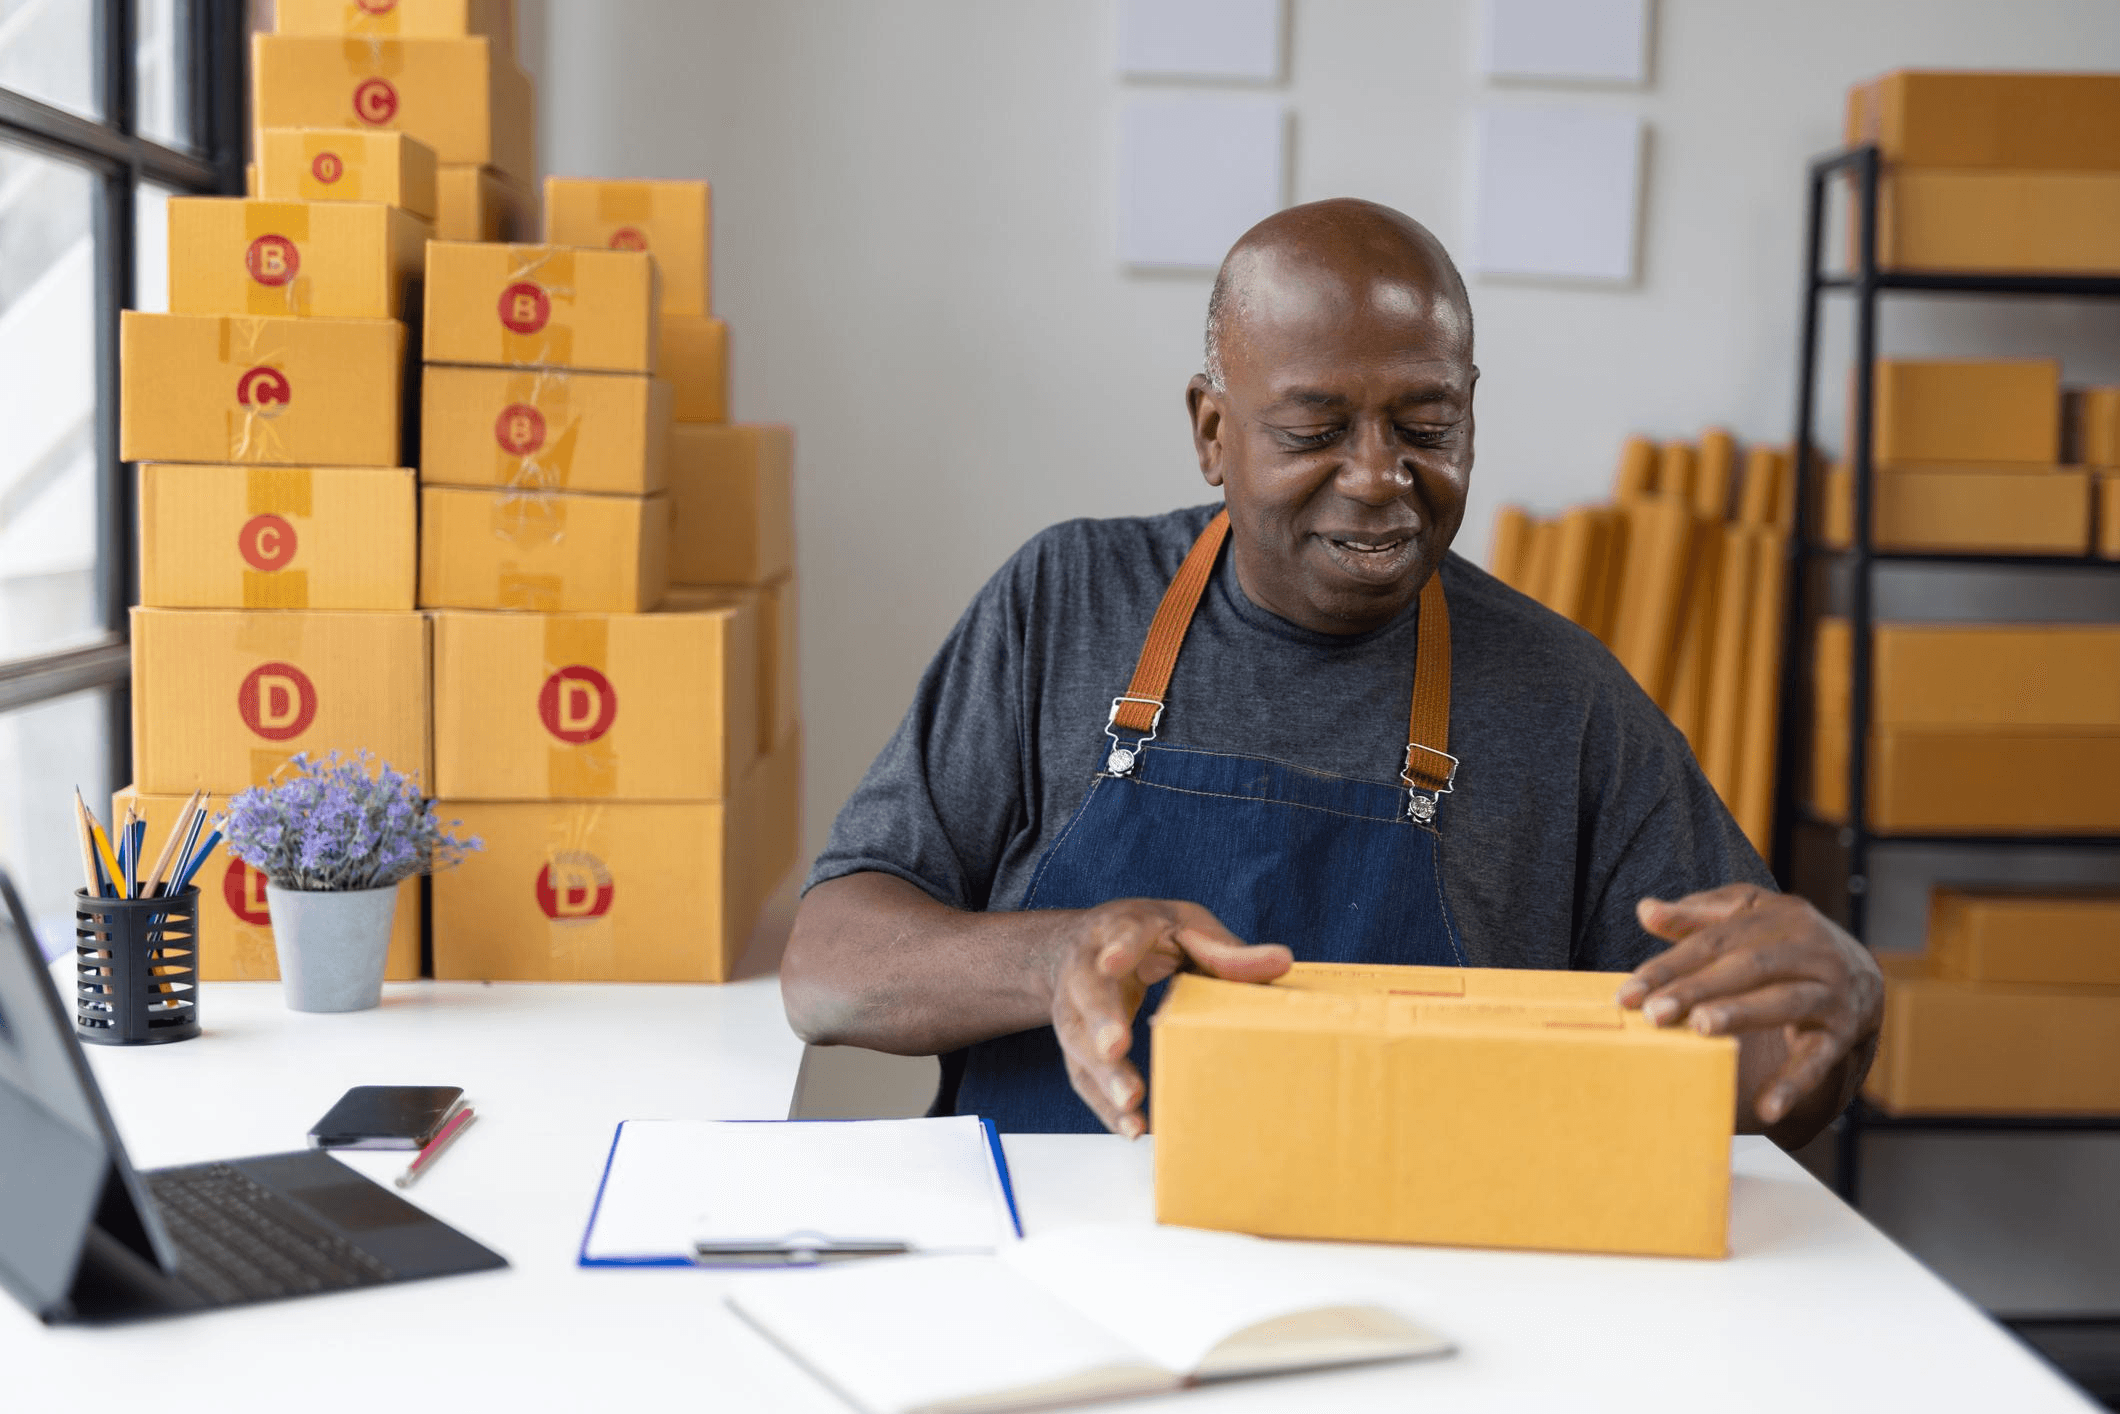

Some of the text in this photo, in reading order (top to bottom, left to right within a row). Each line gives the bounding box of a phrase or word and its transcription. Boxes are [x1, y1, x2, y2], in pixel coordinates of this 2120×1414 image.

[361, 86, 389, 119] C
[260, 243, 287, 275] B
[513, 293, 537, 321] B
[247, 373, 279, 413] C
[510, 416, 531, 442] B
[255, 526, 281, 560] C
[259, 675, 301, 729] D
[560, 679, 601, 731] D
[557, 864, 597, 914] D
